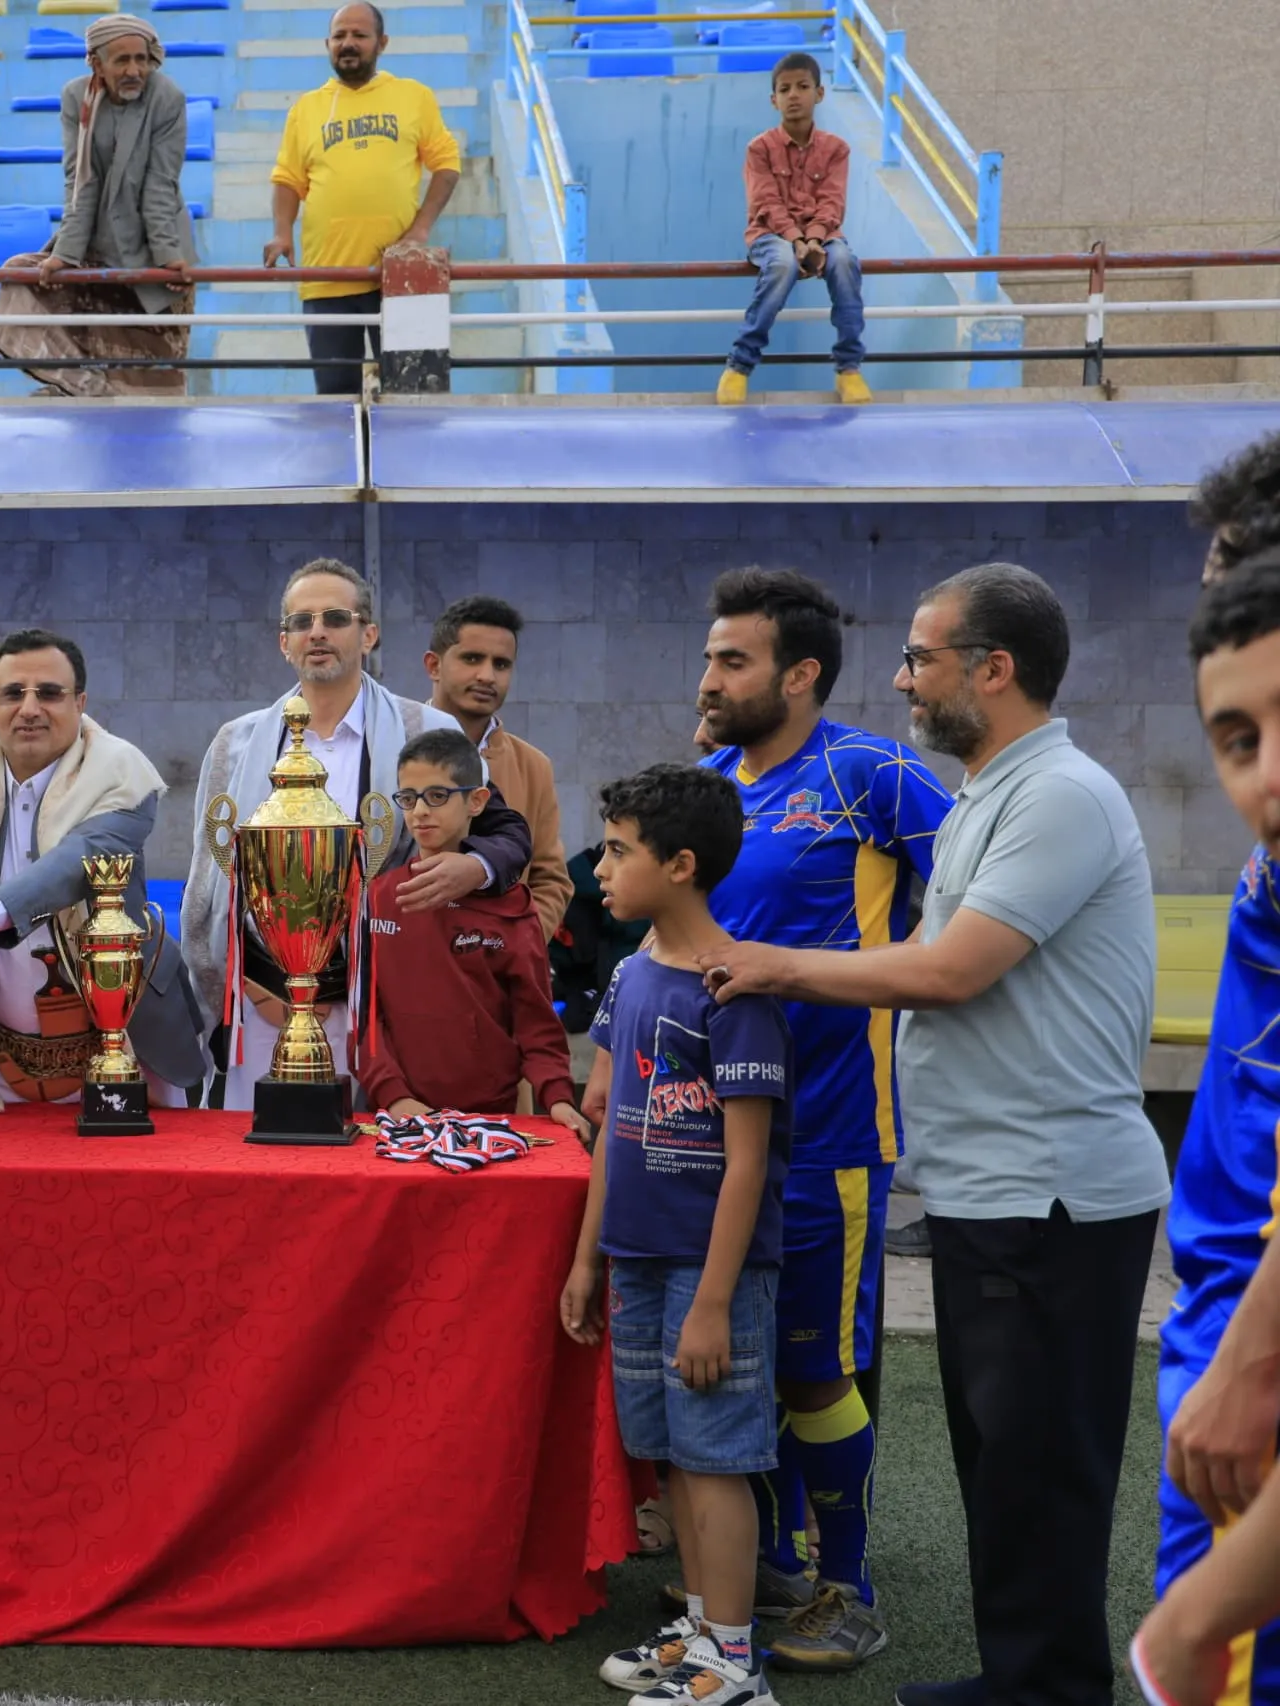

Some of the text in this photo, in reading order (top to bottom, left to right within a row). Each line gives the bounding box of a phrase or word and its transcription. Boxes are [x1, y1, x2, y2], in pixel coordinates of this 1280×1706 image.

[322, 113, 398, 152] LOS ANGELES
[689, 1652, 727, 1669] FASHION
